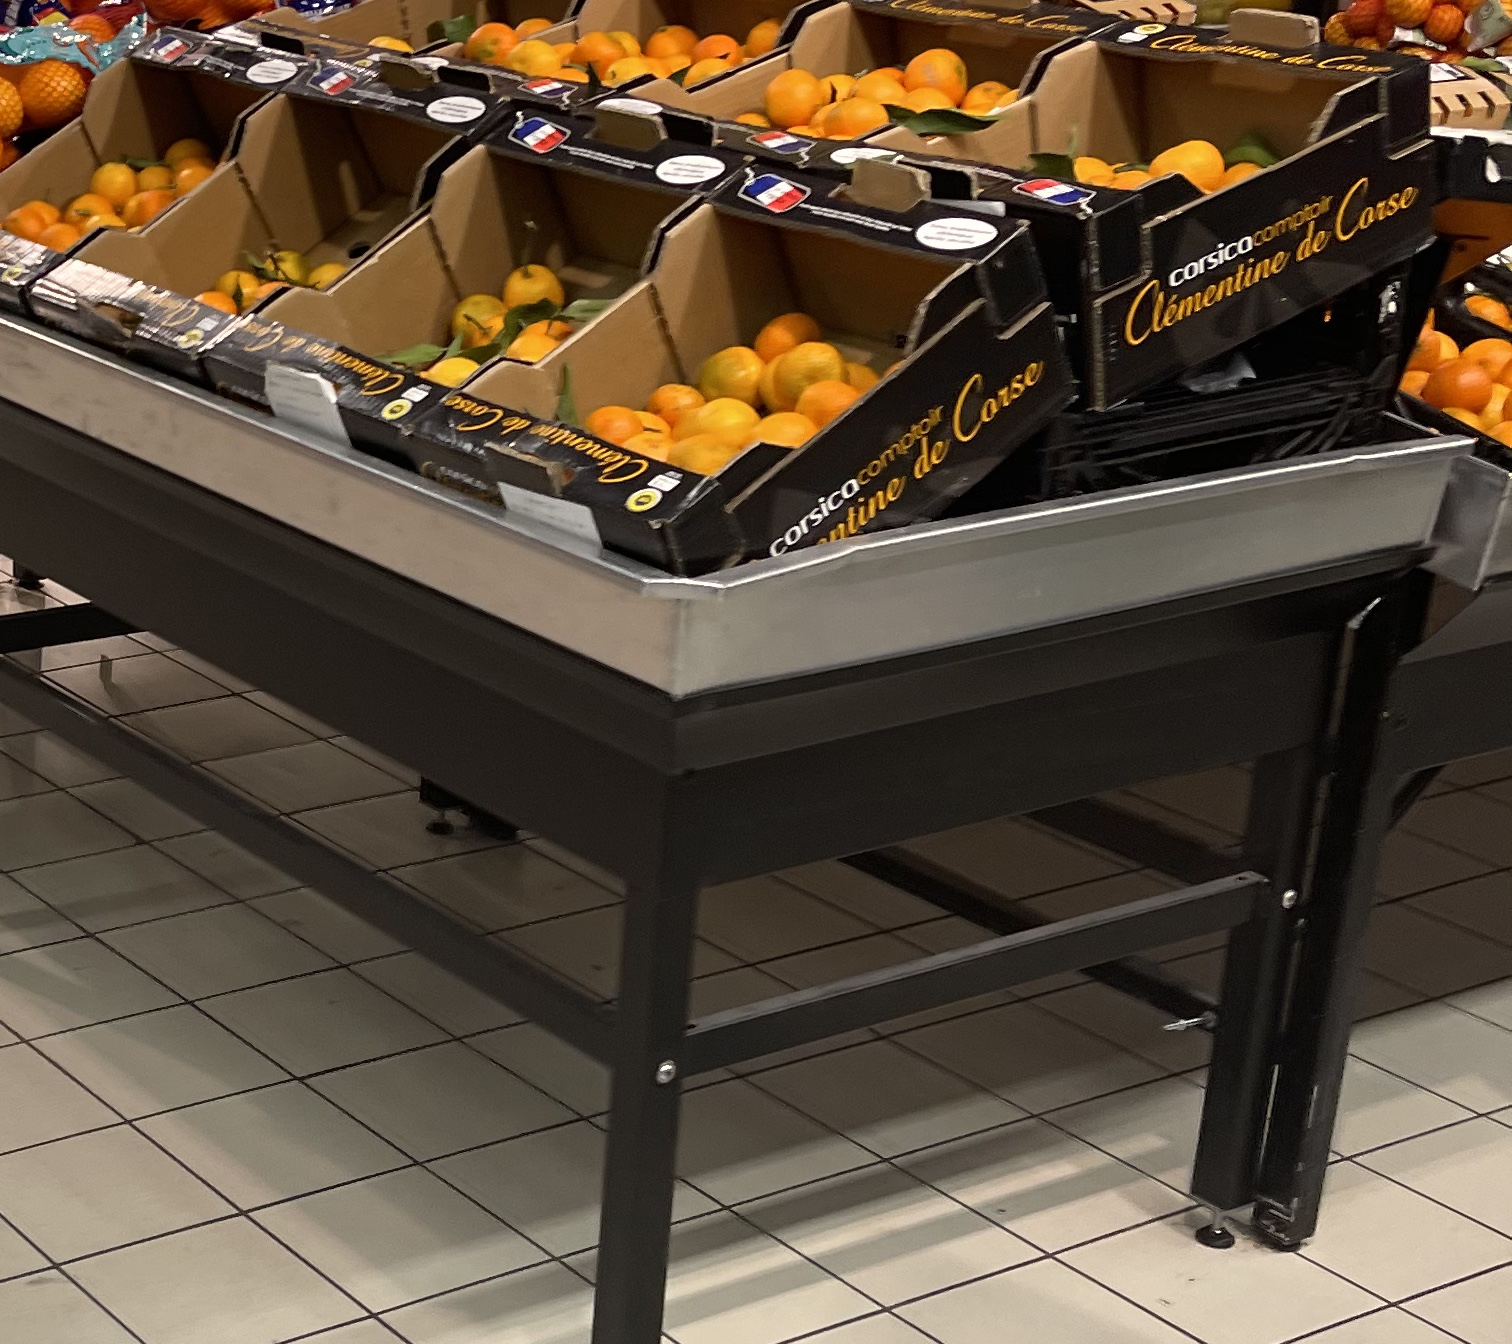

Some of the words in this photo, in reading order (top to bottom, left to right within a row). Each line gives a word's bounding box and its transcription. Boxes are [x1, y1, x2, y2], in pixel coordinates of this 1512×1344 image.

[1282, 50, 1314, 66] de
[1124, 252, 1290, 346] Clémentine
[1296, 222, 1331, 264] de
[1335, 177, 1419, 242] Corse
[445, 394, 503, 431] Corse
[500, 416, 532, 436] de
[913, 437, 950, 479] de
[953, 361, 1046, 442] Corse
[530, 423, 649, 483] Clémentine
